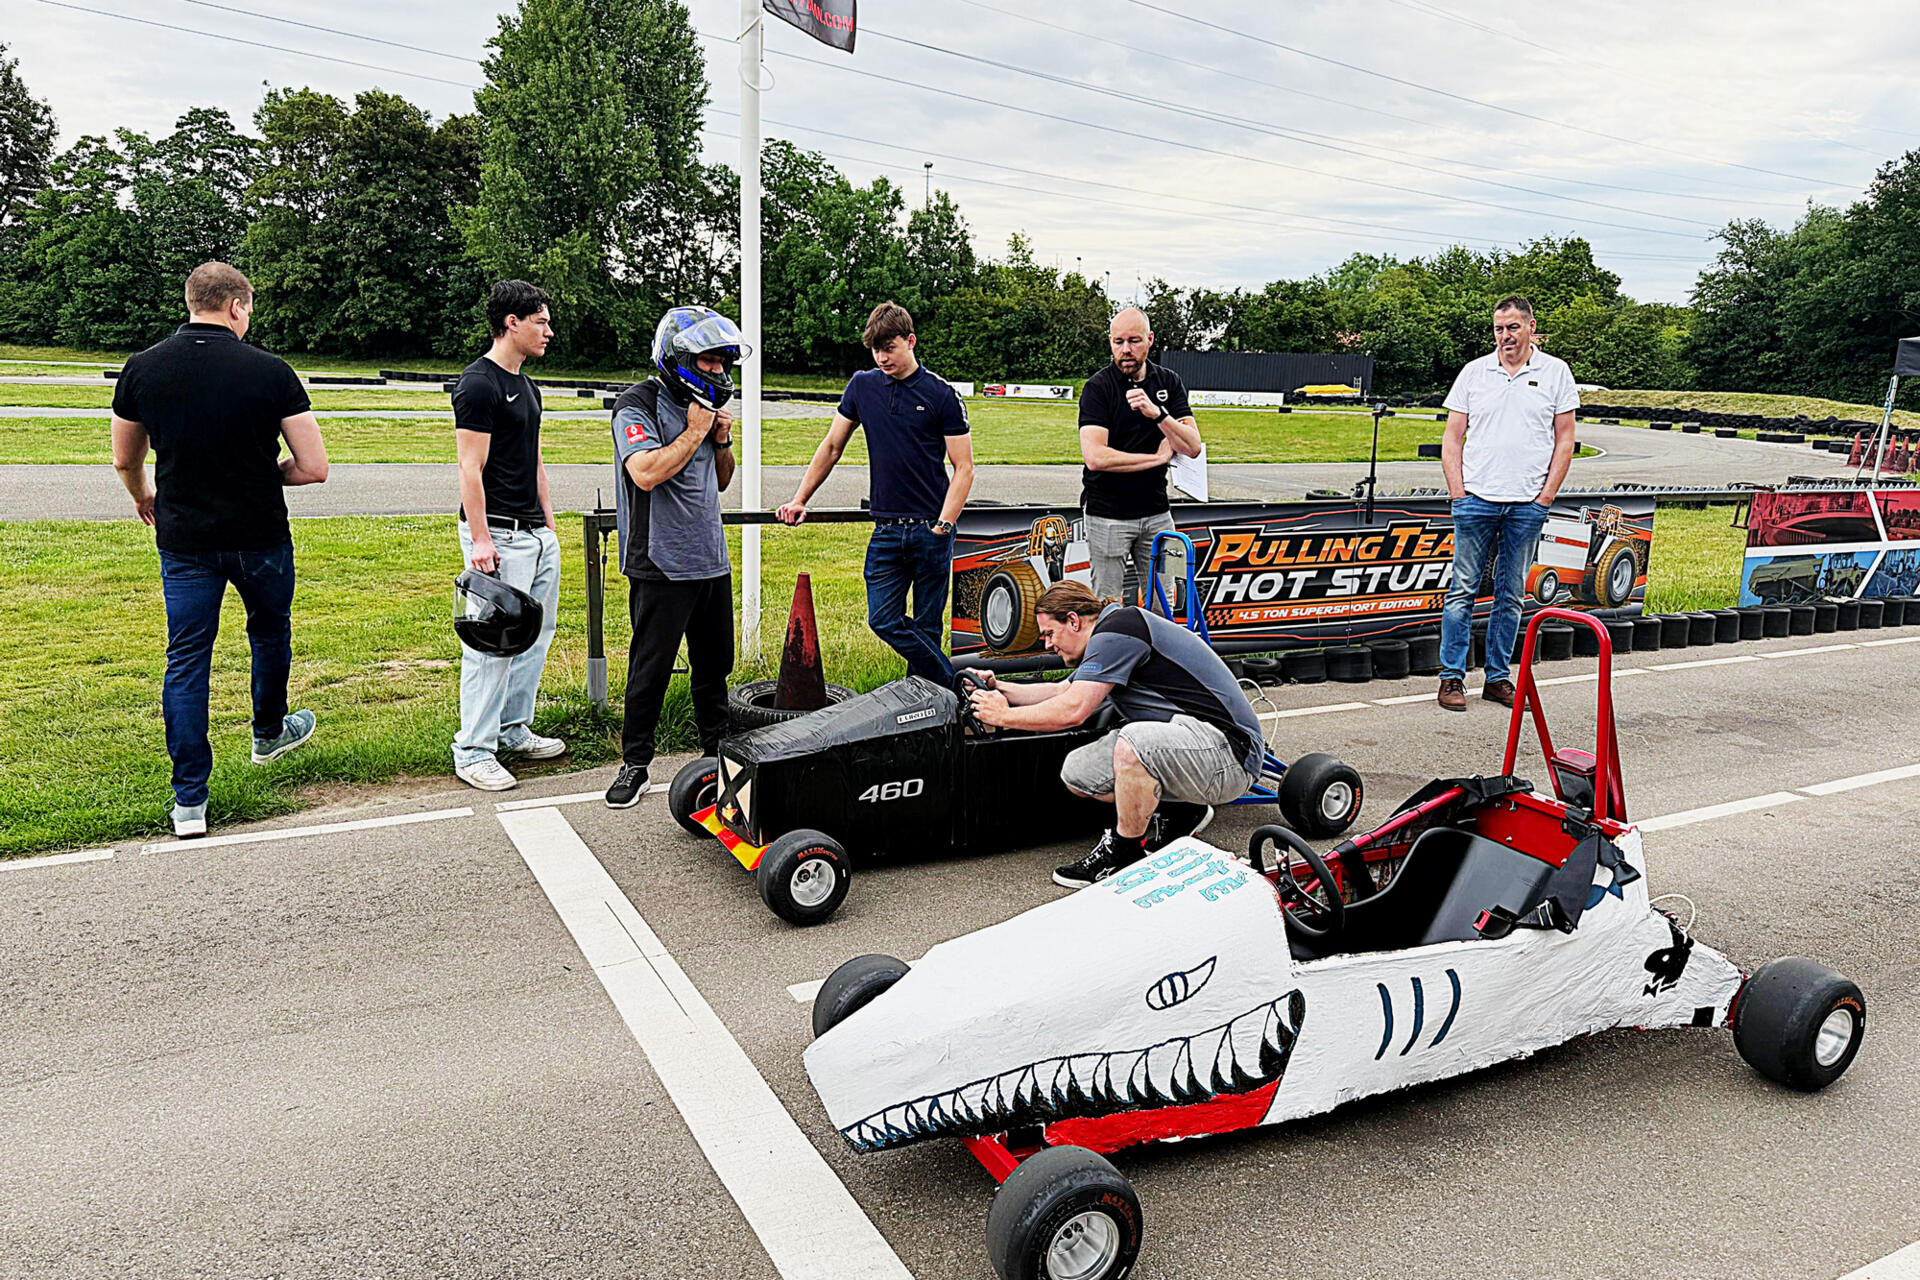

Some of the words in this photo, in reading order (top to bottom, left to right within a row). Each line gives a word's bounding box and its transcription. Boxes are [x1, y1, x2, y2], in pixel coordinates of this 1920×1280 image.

[1207, 532, 1384, 572] PULLING
[1390, 527, 1456, 558] TEA
[1212, 570, 1318, 603] HOT
[1238, 610, 1259, 620] 4.5
[1263, 608, 1288, 619] TON
[1290, 601, 1378, 617] SUPERSPORT
[1378, 598, 1424, 610] EDITION
[858, 778, 924, 803] 460
